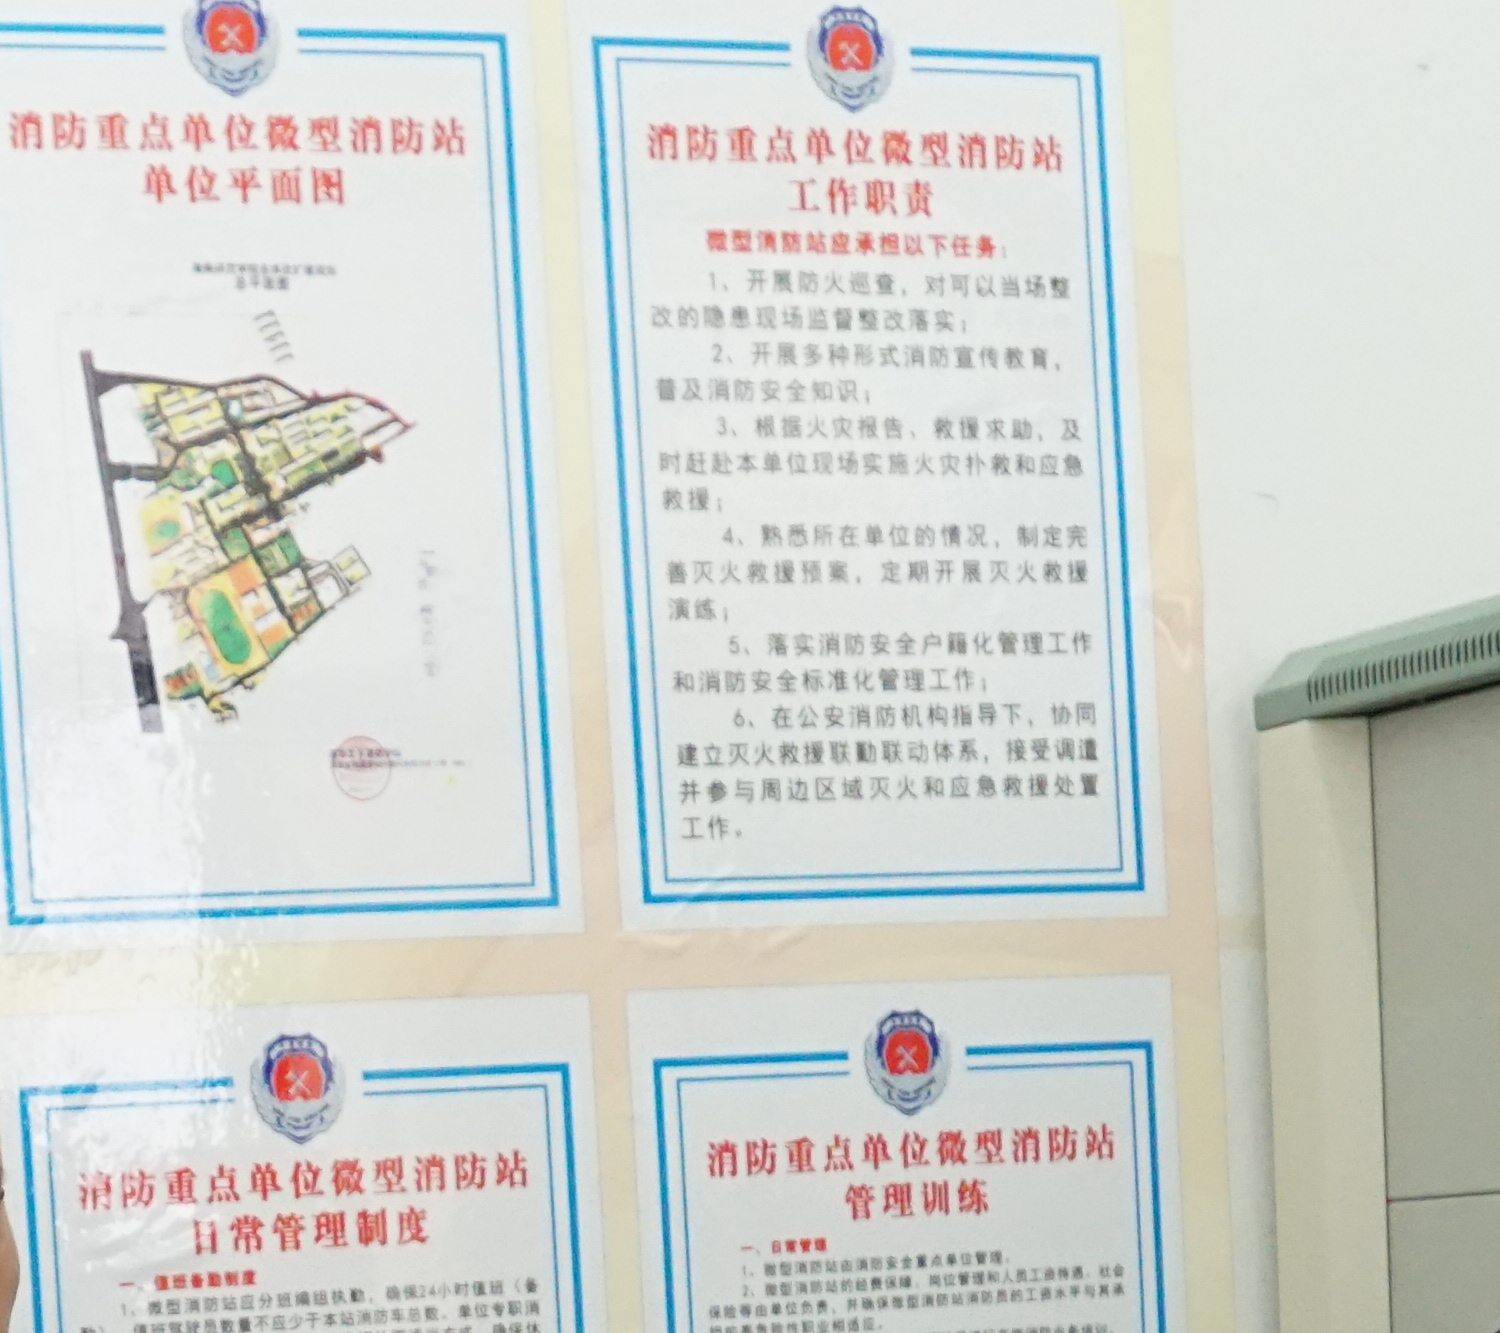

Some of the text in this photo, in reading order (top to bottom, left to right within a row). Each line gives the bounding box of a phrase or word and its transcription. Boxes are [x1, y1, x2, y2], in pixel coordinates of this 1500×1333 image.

[9, 109, 467, 157] 消防重点单位微型消防站
[647, 122, 1064, 173] 消防重点单位微型消防站
[142, 163, 347, 206] 单位平面图
[788, 176, 935, 218] 工作职责
[707, 1122, 1116, 1179] 消防重点单位微型消防站
[78, 1149, 531, 1211] 消防重点单位微型消防站
[844, 1177, 990, 1221] 管理训练
[191, 1205, 431, 1257] 日常管理制度
